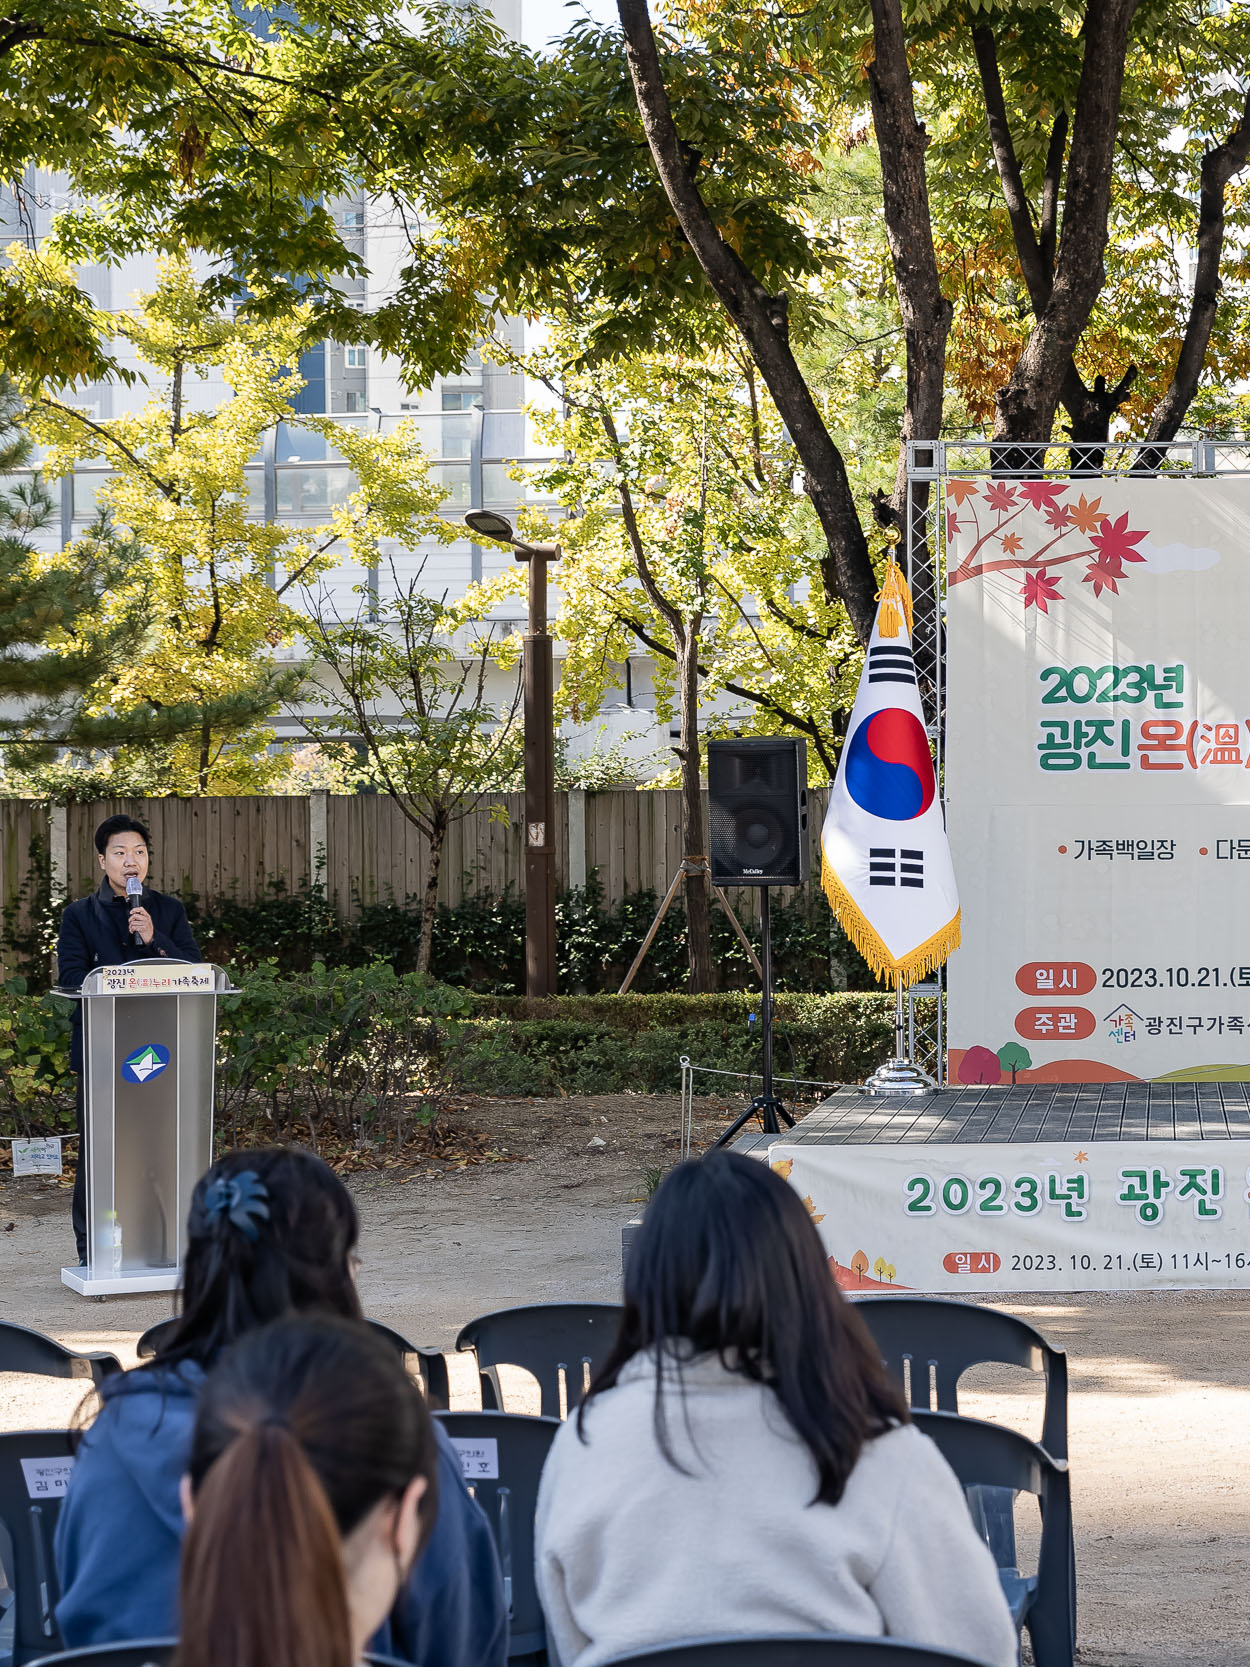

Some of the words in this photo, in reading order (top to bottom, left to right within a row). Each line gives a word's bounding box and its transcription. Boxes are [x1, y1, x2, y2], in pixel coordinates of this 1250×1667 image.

[1039, 664, 1184, 709] 2023년
[1037, 719, 1131, 771] 광진
[1073, 839, 1176, 860] 가족백일장
[107, 968, 135, 976] 2023년
[107, 978, 126, 989] 광진
[906, 1174, 1084, 1218] 2023년
[1119, 1168, 1220, 1222] 광진
